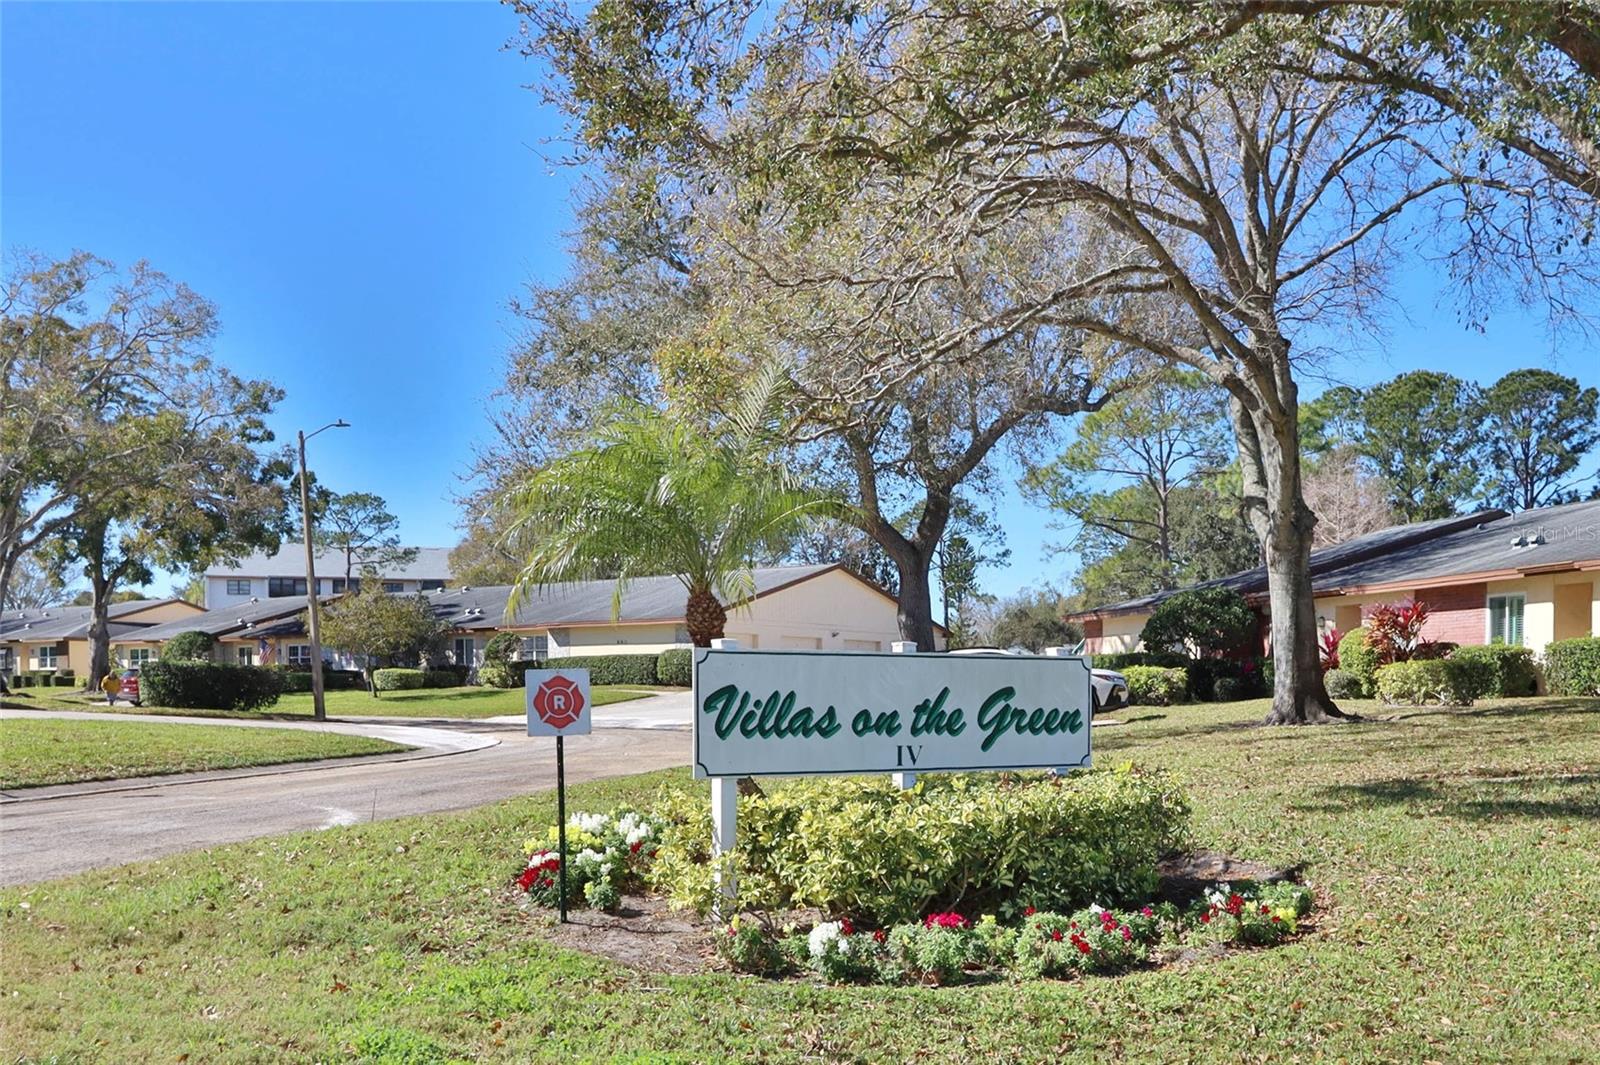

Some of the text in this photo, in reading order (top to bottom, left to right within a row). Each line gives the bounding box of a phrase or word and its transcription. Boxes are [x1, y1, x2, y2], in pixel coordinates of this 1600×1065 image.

[553, 695, 566, 709] R
[703, 684, 1083, 752] Villas on the Green
[896, 745, 922, 767] IV
